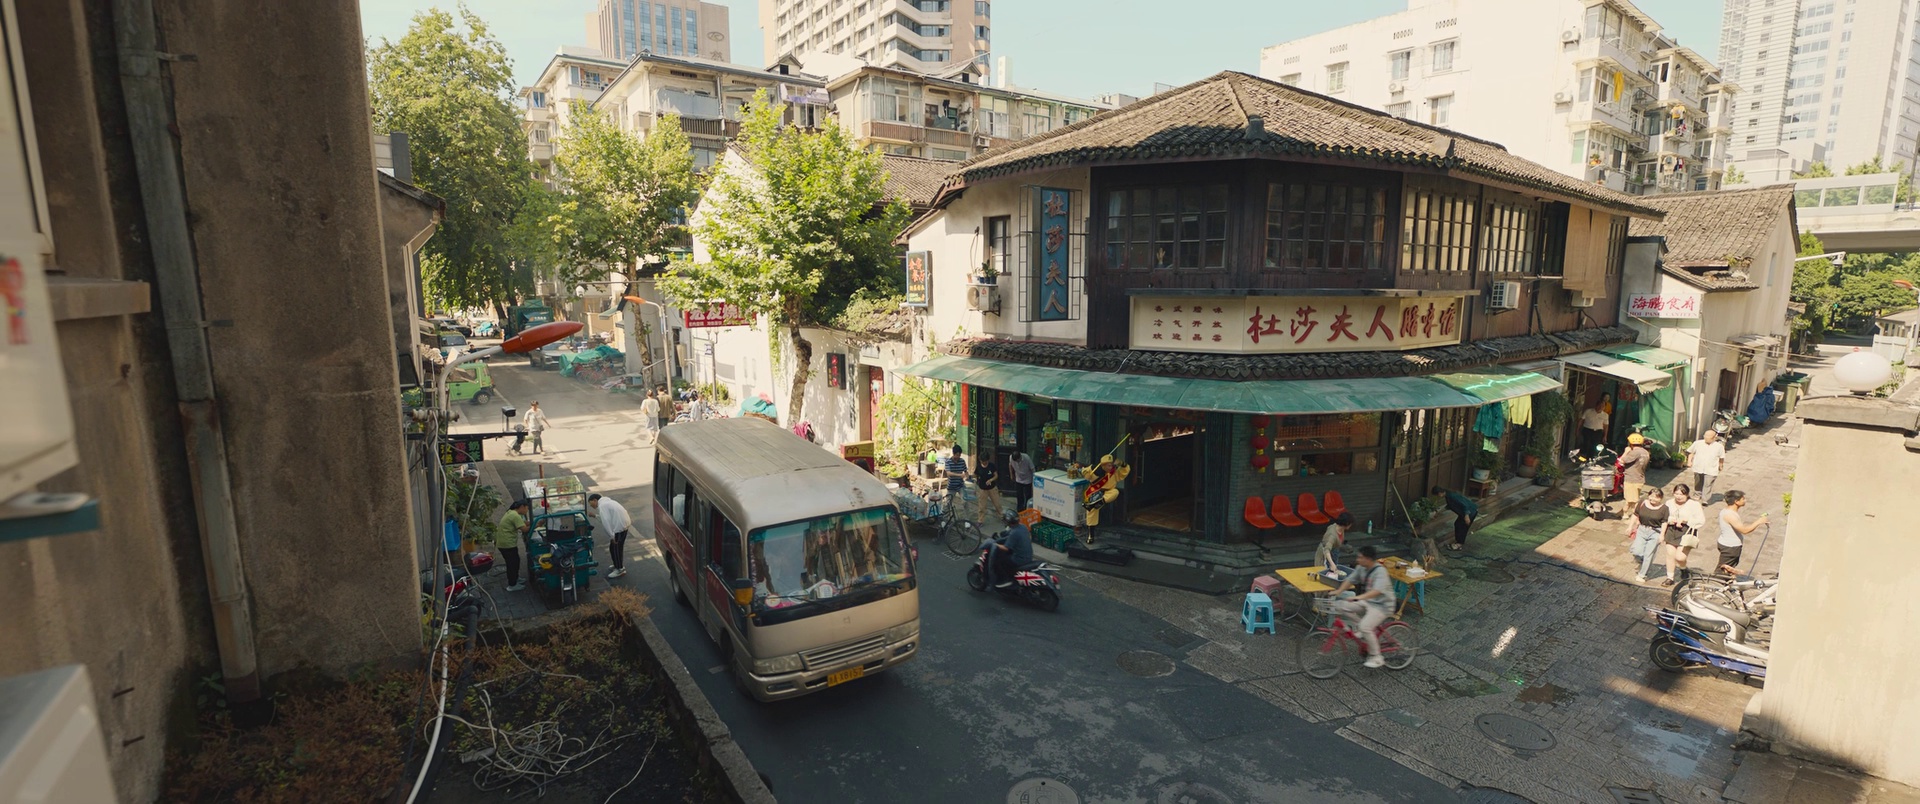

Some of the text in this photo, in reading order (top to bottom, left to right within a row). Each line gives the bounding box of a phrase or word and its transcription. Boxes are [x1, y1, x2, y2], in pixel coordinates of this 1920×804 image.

[1043, 191, 1067, 314] 杜莎夫人
[1632, 295, 1695, 311] 海鹏食府
[1153, 319, 1223, 328] 冷气开放
